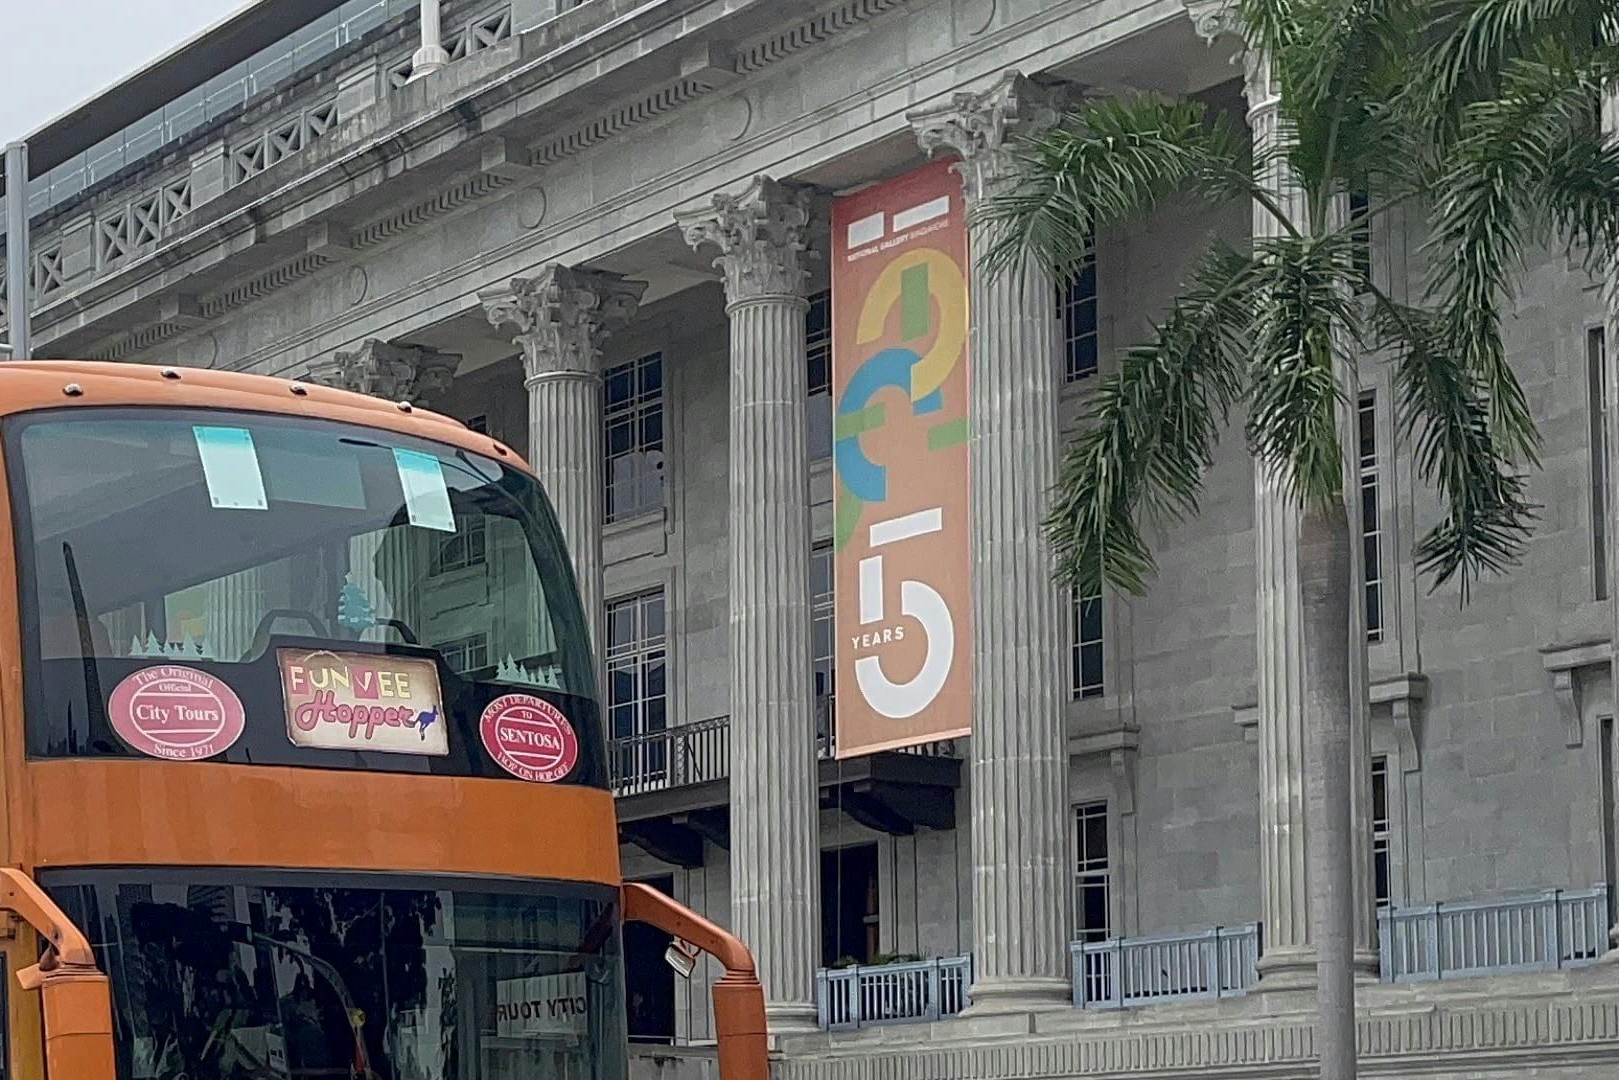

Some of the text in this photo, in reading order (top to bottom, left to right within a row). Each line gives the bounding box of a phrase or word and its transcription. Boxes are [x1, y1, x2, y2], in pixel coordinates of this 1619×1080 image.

[851, 626, 905, 650] YEARS
[132, 667, 214, 689] The Original
[290, 665, 412, 699] FUNVEE
[136, 704, 219, 724] City Tours
[295, 690, 415, 740] Hopper
[483, 695, 572, 735] MOST DEPARTURES
[520, 710, 533, 720] TO
[154, 743, 214, 757] Since 1971
[500, 727, 561, 750] SENTOSA
[497, 751, 569, 780] HOP ON HOP OFF
